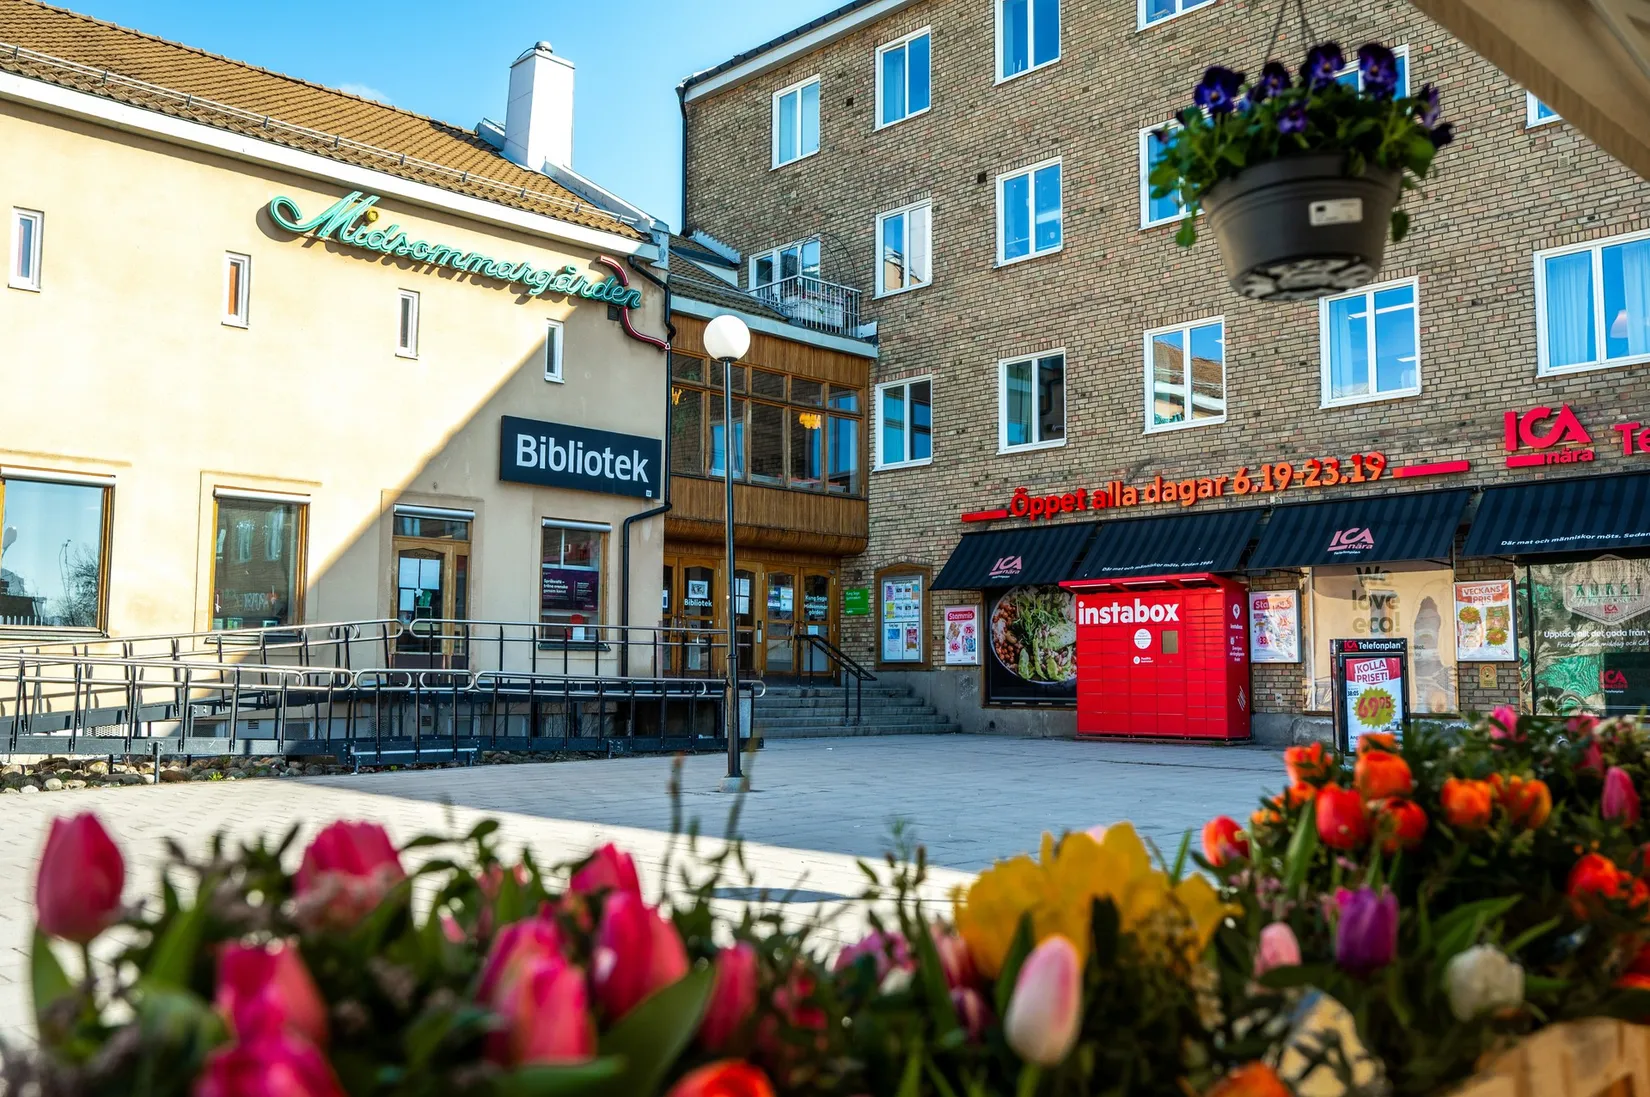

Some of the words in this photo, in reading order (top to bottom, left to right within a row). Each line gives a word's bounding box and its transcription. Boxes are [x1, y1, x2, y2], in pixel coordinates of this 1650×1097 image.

[270, 191, 641, 309] Midsommargården
[1504, 404, 1592, 451] ICA
[516, 433, 649, 483] Bibliotek
[1546, 448, 1594, 464] nära
[1010, 487, 1087, 521] Öppet
[1092, 480, 1139, 507] alla
[1144, 476, 1229, 507] dagar
[1233, 451, 1386, 495] 6.19-23.19
[1330, 527, 1374, 546] ICA
[992, 556, 1022, 571] ICA
[1463, 585, 1501, 595] VECKANS
[684, 598, 712, 607] Bibliotek
[1352, 589, 1400, 610] love
[1473, 595, 1492, 603] PRIS
[1078, 598, 1180, 625] instabox
[1352, 612, 1400, 633] eco!
[1606, 630, 1627, 638] goda
[1629, 628, 1645, 636] från
[1358, 641, 1400, 650] Telefonplan
[1356, 660, 1385, 674] KOLLA
[1356, 672, 1388, 683] PRISET!
[1599, 670, 1628, 683] ICA
